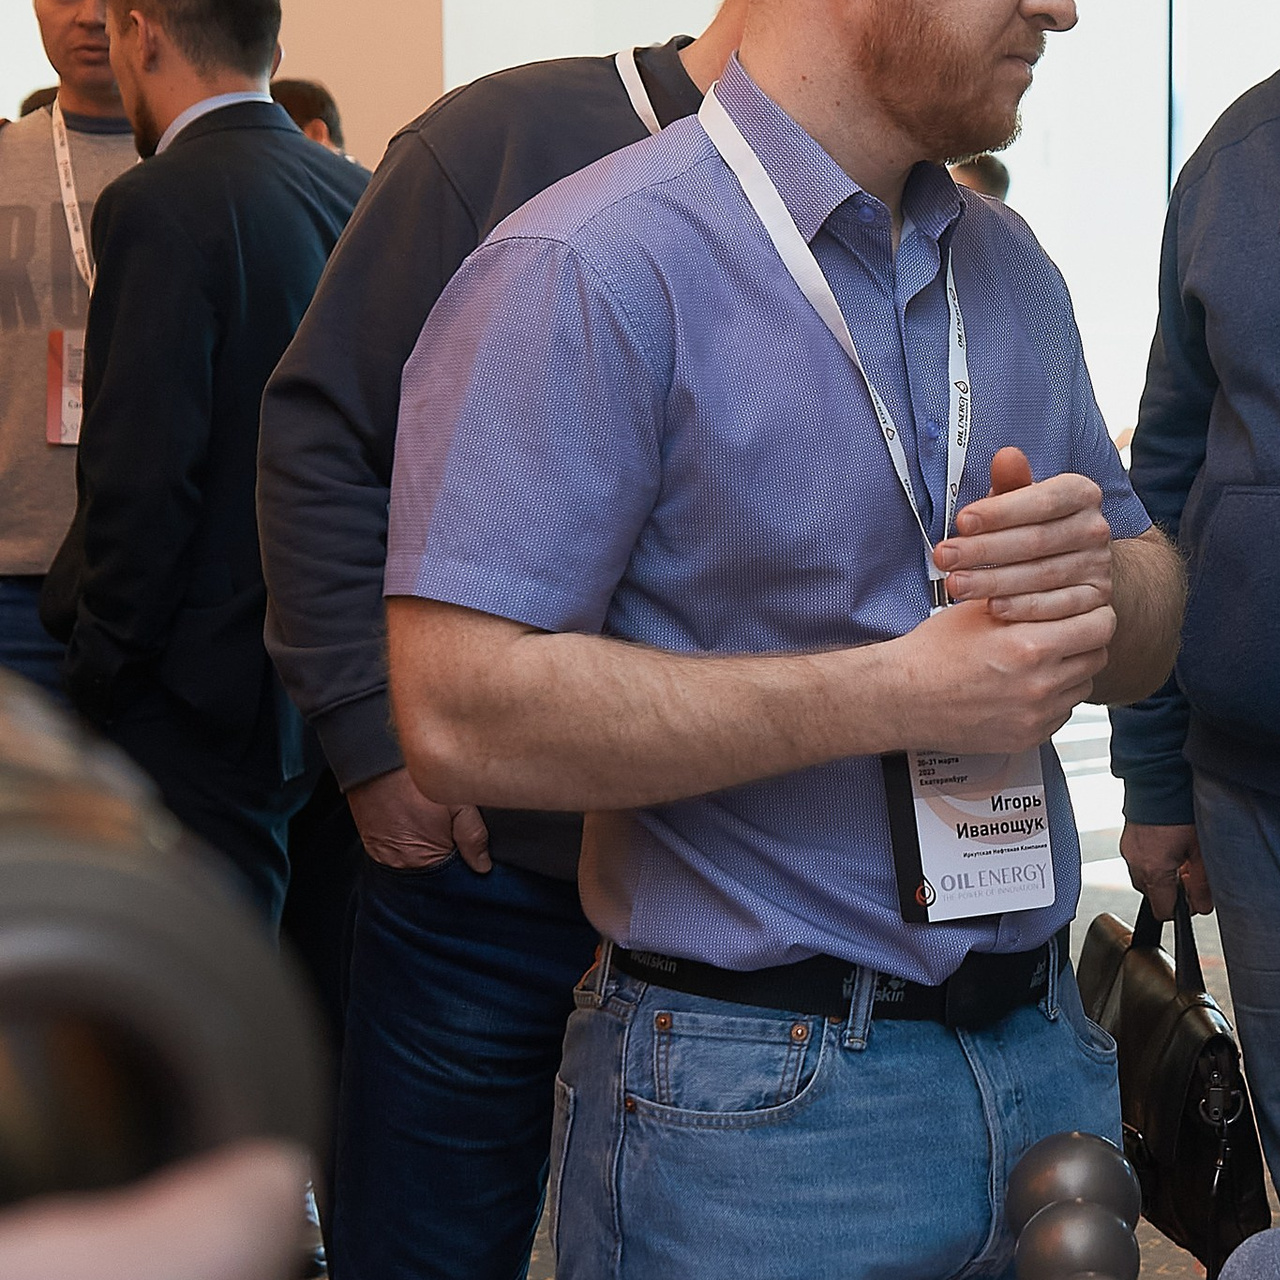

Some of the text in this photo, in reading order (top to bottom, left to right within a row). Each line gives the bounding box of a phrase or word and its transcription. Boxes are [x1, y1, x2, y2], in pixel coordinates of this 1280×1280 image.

[958, 396, 968, 429] ENERGY
[918, 768, 935, 776] 2023
[920, 775, 968, 786] Екатеринбург
[991, 795, 1042, 812] Игорь
[956, 817, 1045, 839] Иванощук
[963, 843, 1048, 858] Иркутская Нефтяная Компания
[940, 863, 1047, 892] OIL ENERGY
[958, 890, 983, 899] POWER
[997, 883, 1039, 894] INNOVATION
